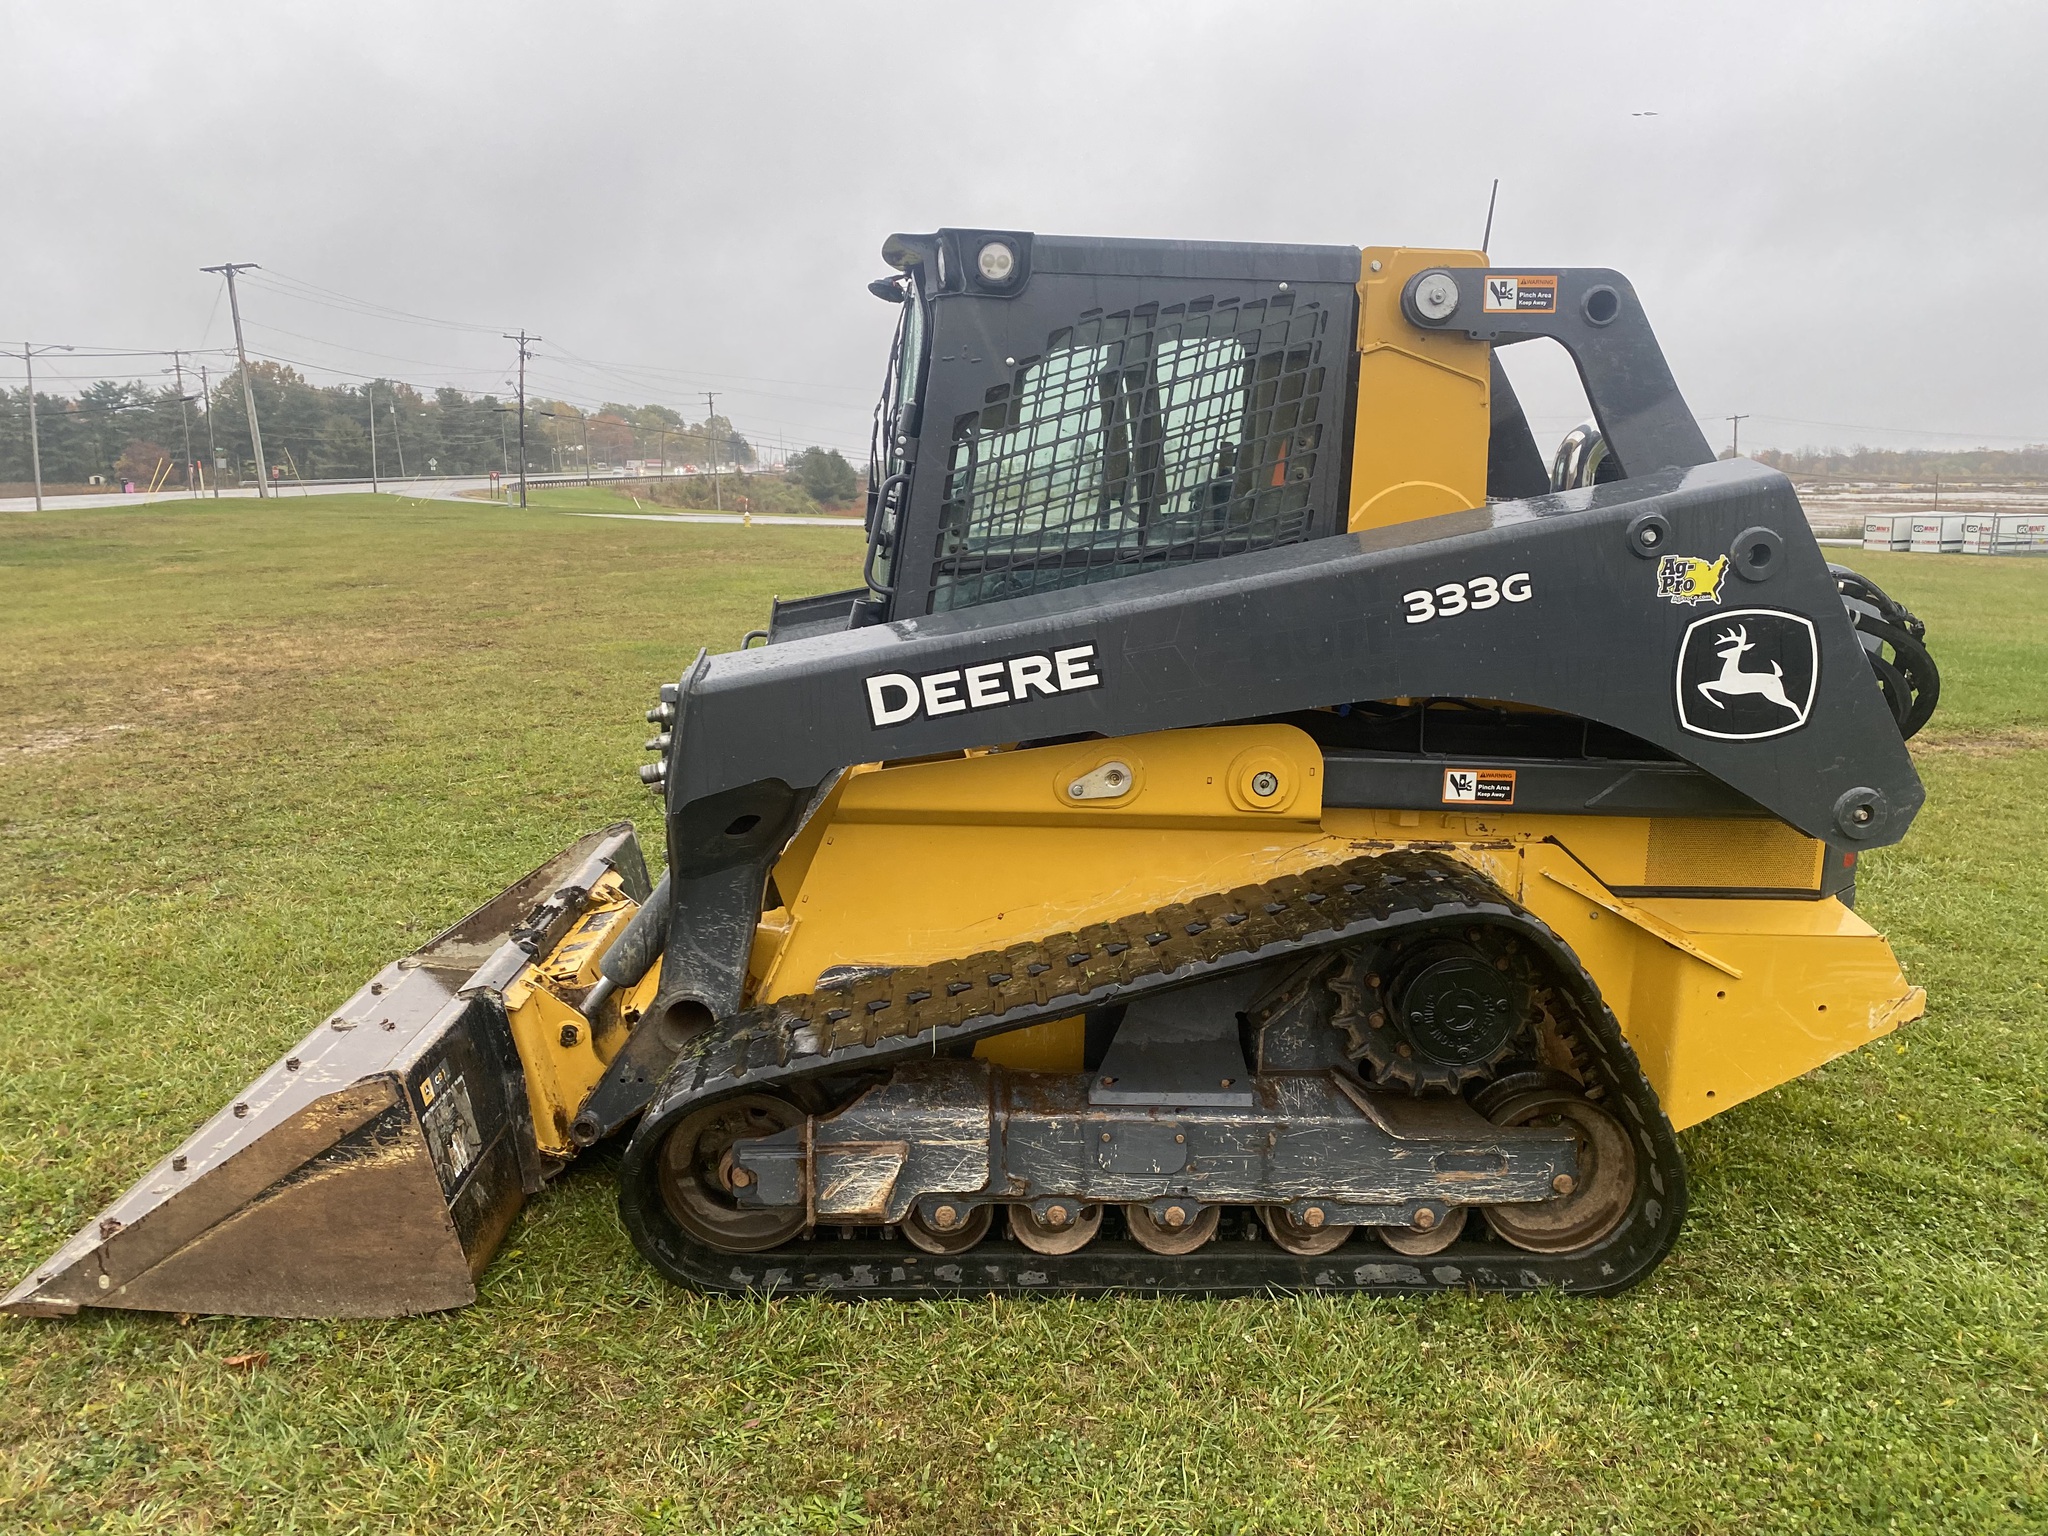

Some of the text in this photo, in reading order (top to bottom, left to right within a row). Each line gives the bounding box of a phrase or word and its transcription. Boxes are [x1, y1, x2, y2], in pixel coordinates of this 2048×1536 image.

[1402, 572, 1532, 623] 333G
[1661, 576, 1695, 593] Pro
[865, 644, 1100, 727] DEERE
